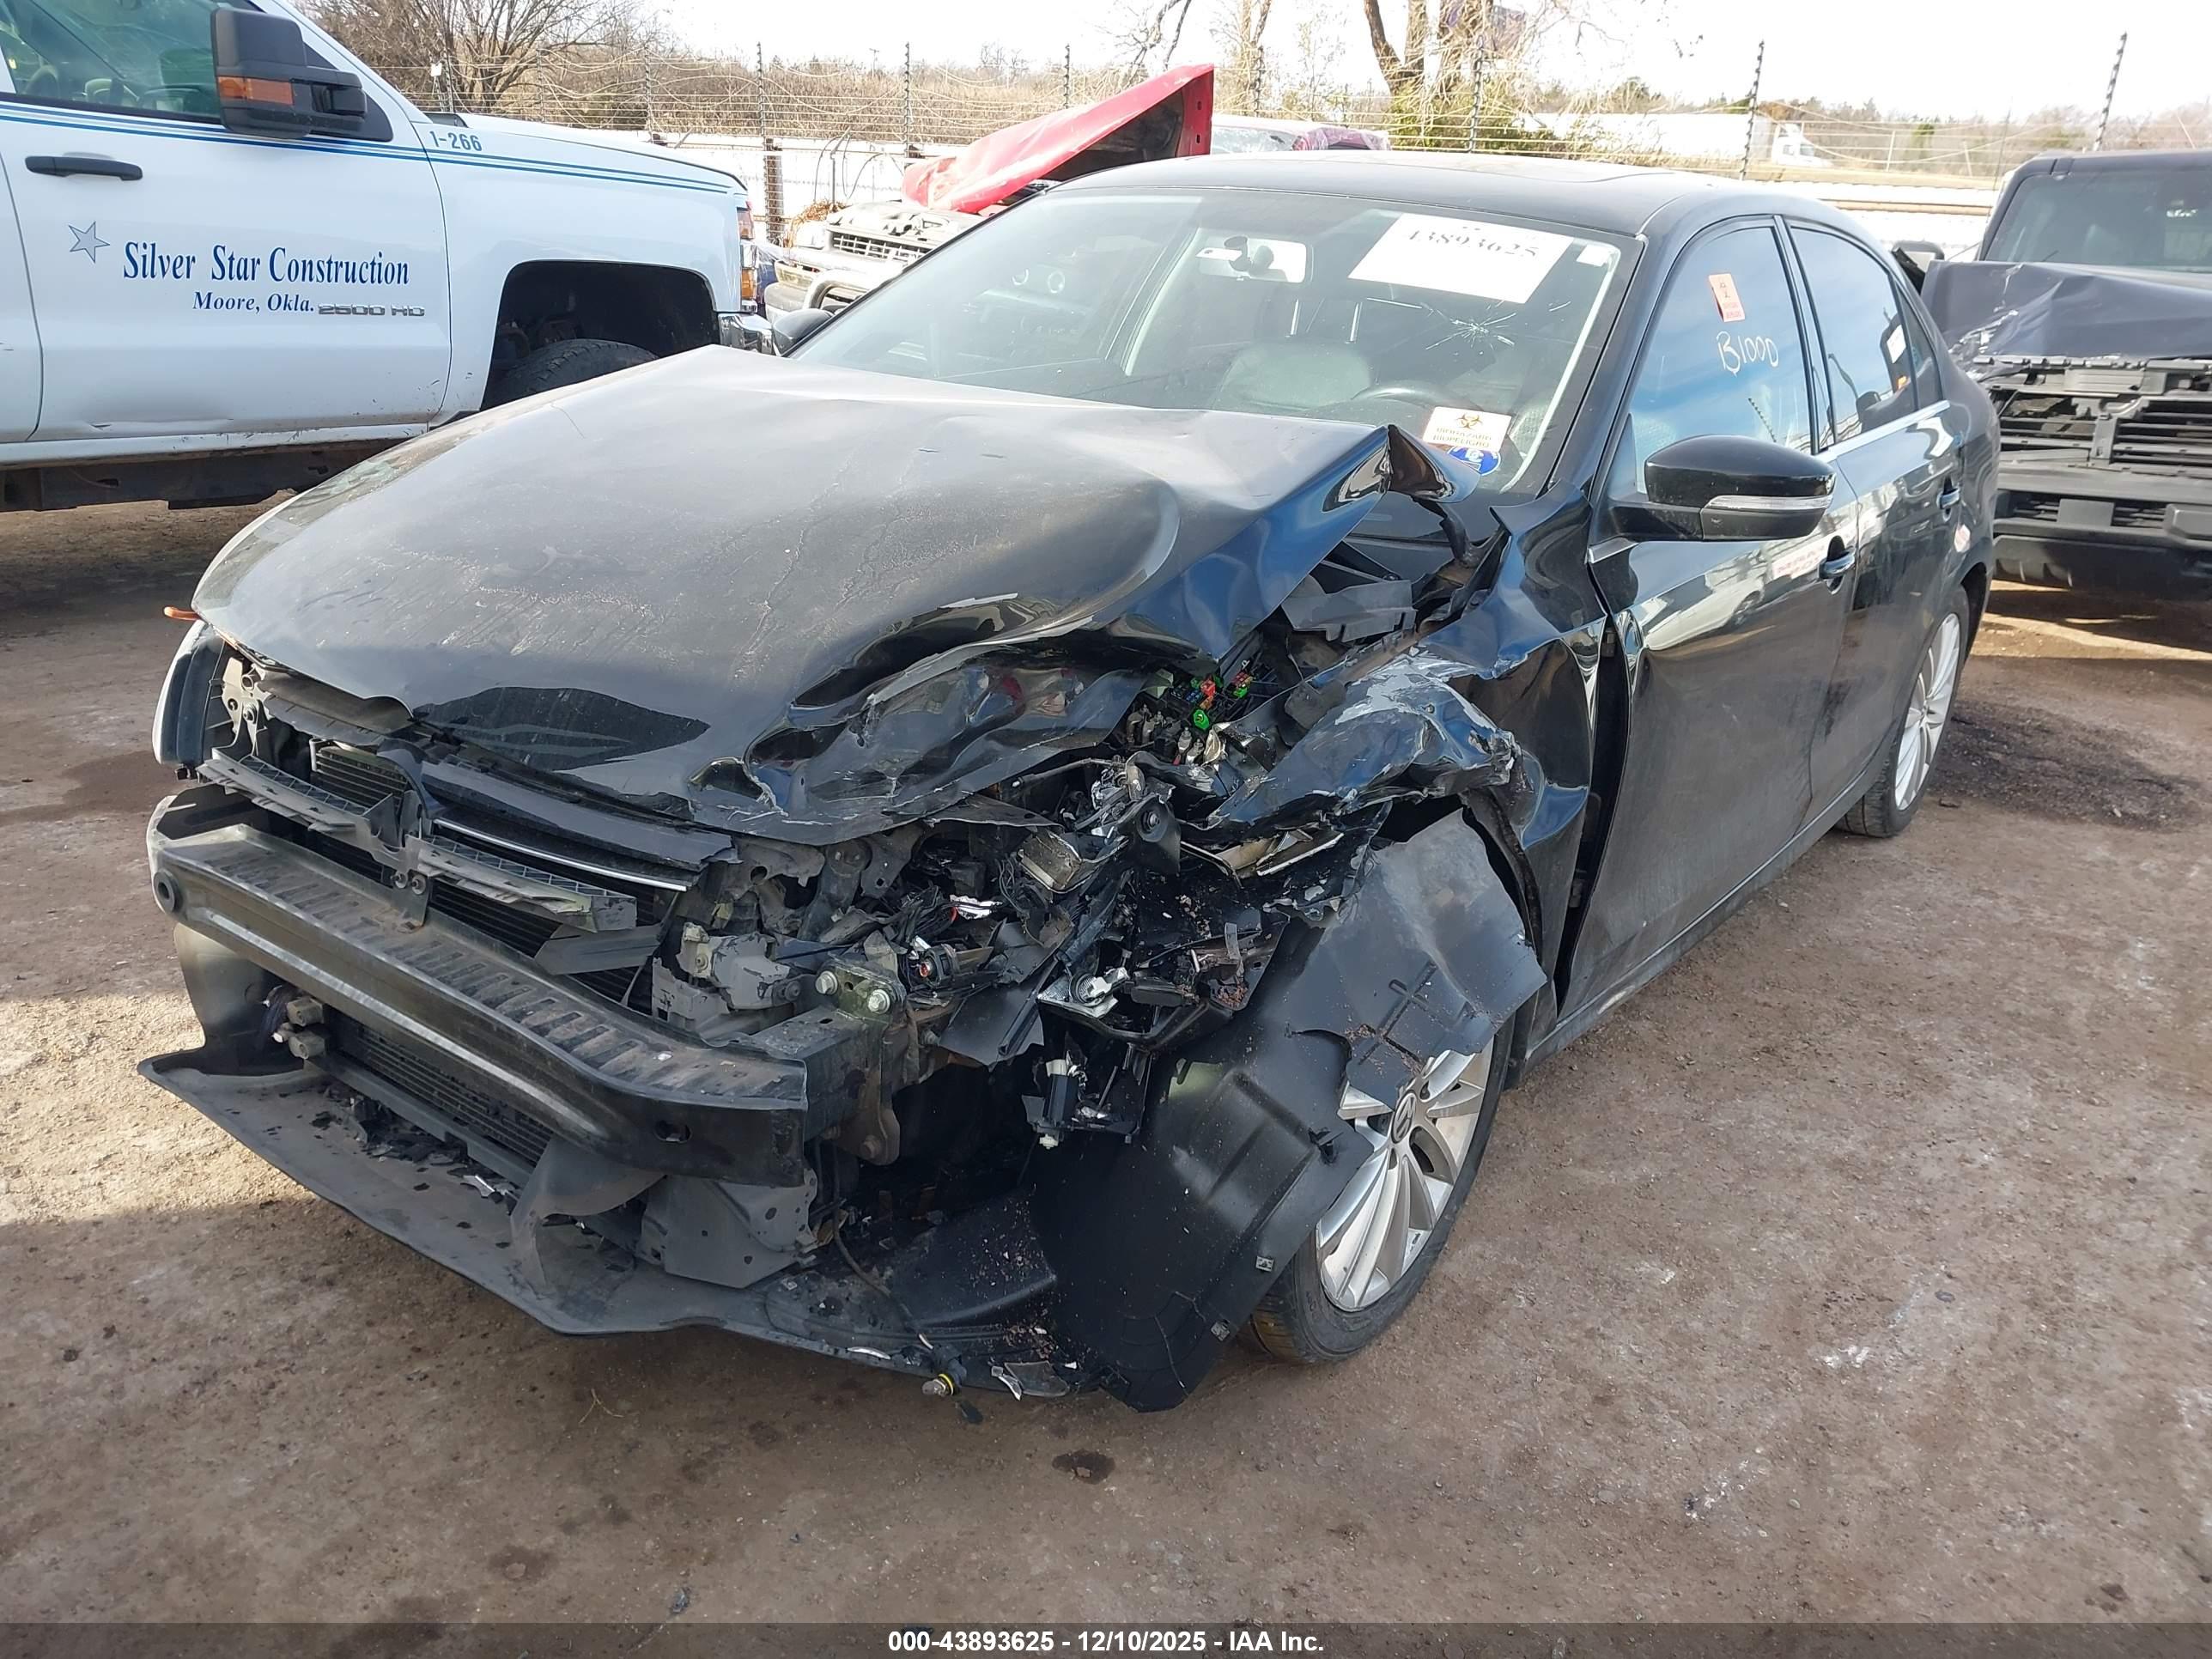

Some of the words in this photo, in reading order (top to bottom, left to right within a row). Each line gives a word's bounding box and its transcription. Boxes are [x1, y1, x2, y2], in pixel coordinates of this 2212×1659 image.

[429, 131, 483, 151] 1-266
[124, 241, 196, 280] Silver
[212, 245, 260, 281] Star
[269, 247, 410, 284] Construction
[192, 292, 259, 314] Moore,
[267, 294, 314, 312] Okla.
[319, 304, 386, 316] 2500
[392, 305, 425, 317] HD
